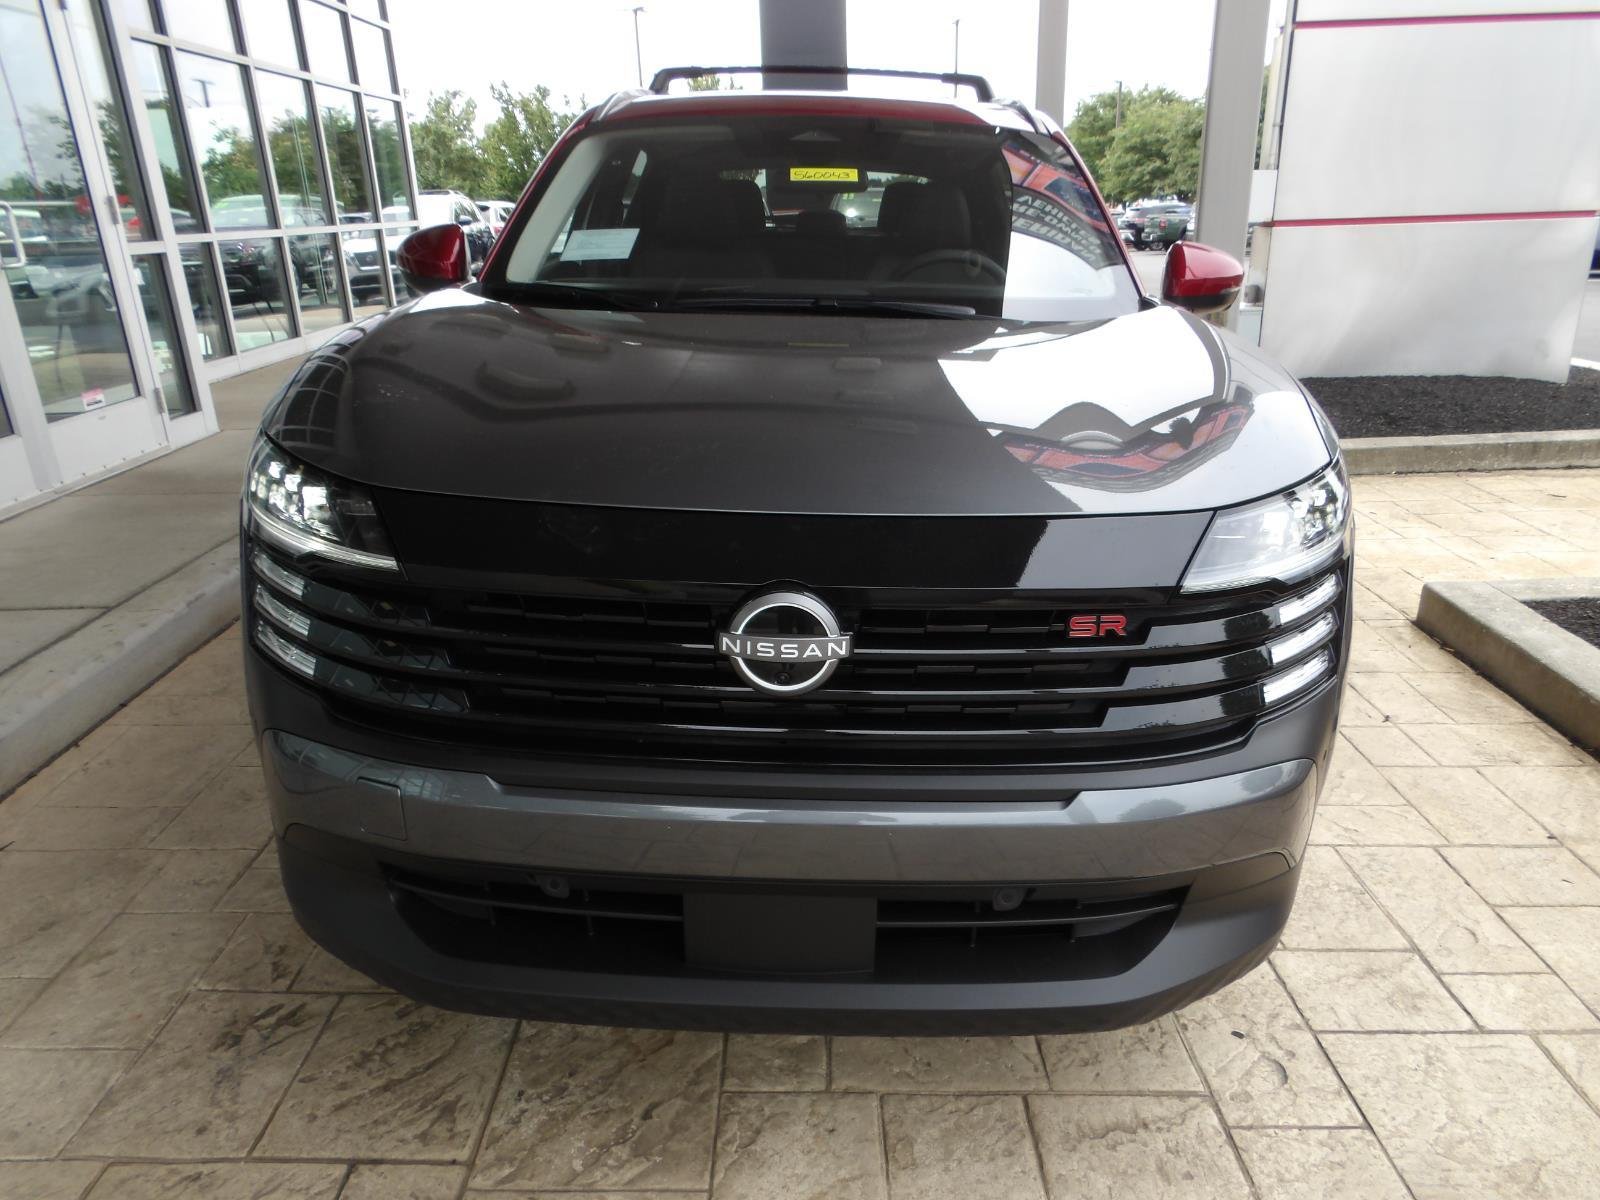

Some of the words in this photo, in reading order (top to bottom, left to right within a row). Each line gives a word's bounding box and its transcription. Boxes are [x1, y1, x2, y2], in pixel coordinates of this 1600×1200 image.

[794, 170, 850, 180] 560043
[1069, 615, 1127, 637] SR
[721, 637, 846, 658] NISSAN
